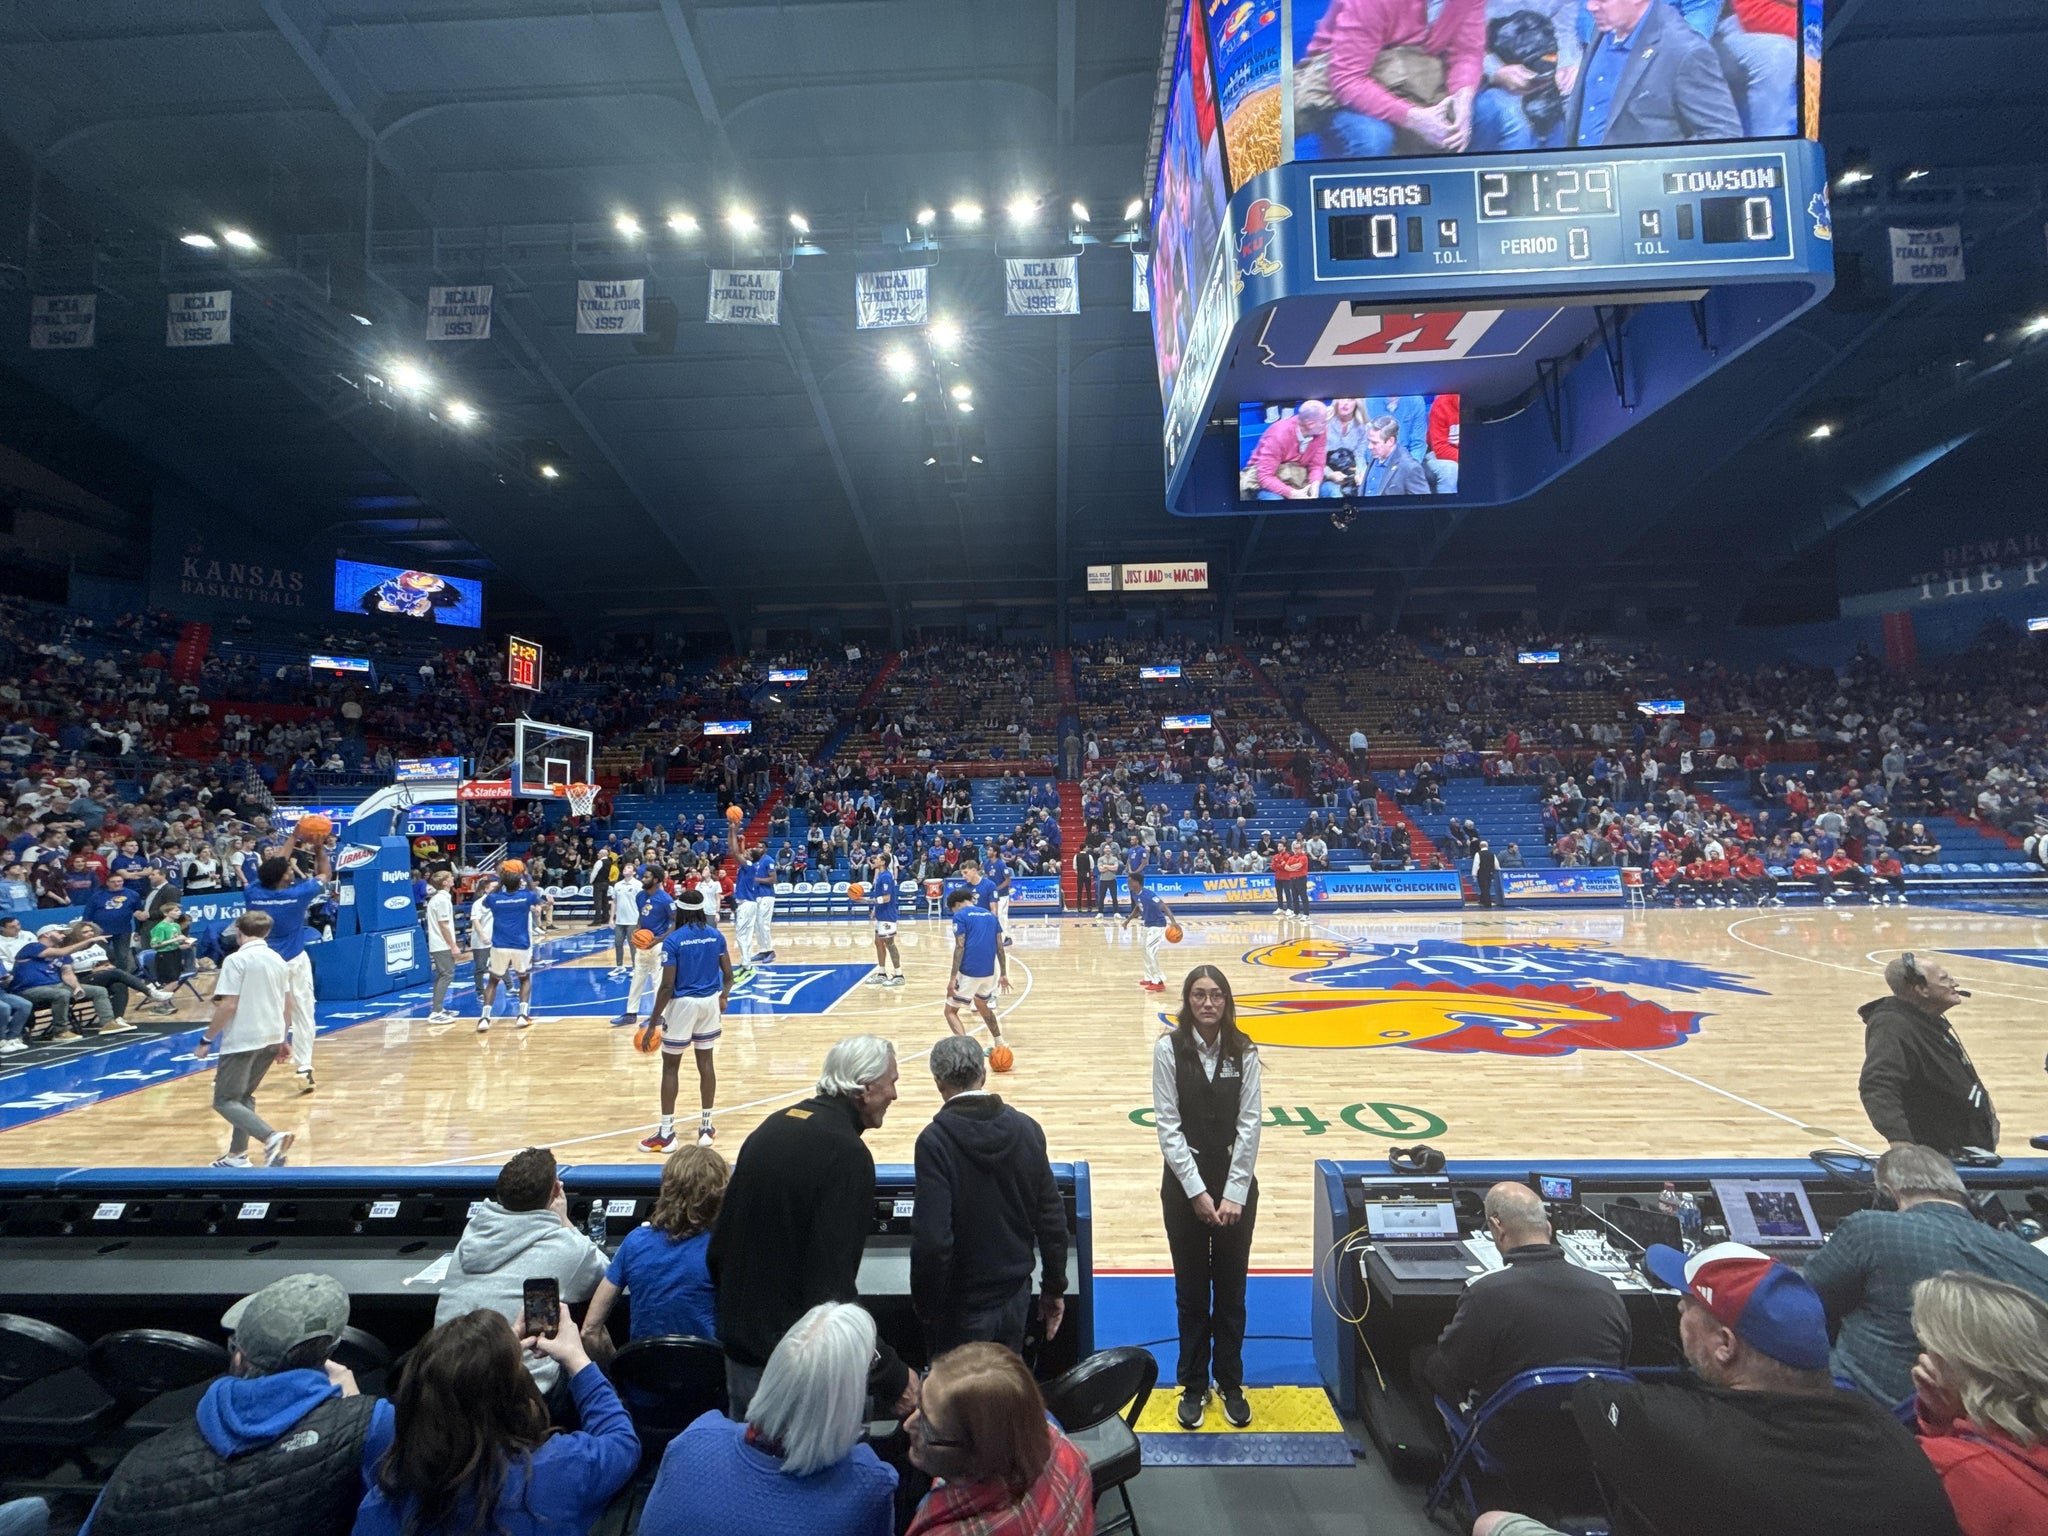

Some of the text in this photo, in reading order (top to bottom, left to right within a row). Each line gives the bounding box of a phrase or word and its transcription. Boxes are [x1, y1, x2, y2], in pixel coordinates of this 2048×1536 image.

[1671, 168, 1776, 193] TOWSON
[1323, 184, 1422, 209] KANSAS
[1484, 169, 1611, 216] 21:29
[1642, 213, 1659, 235] 4
[1745, 196, 1773, 240] 0
[1371, 214, 1398, 258] 0
[1440, 221, 1457, 244] 4
[1501, 237, 1558, 255] PERIOD
[1569, 228, 1589, 259] 0
[1634, 241, 1670, 255] T.O.L.
[1433, 251, 1468, 264] T.O.L.
[1023, 263, 1057, 276] NCAA
[729, 274, 762, 288] NCAA
[875, 275, 908, 289] NCAA
[1010, 278, 1072, 289] FINAL FOUR
[595, 285, 626, 298] NCAA
[714, 289, 776, 301] FINAL FOUR
[862, 289, 923, 303] FINAL FOUR
[580, 299, 640, 310] FINAL FOUR
[1026, 296, 1056, 309] 1986
[730, 306, 757, 318] 1971
[182, 556, 304, 592] KANSAS
[1125, 570, 1142, 584] JUST
[1144, 570, 1163, 583] LOAD
[1174, 568, 1206, 582] WAGON
[181, 579, 305, 607] BASKETBALL
[397, 592, 413, 602] KU
[511, 642, 537, 661] 21:29
[514, 658, 533, 684] 30
[408, 824, 415, 832] 0
[339, 849, 373, 866] LIBMAN
[1158, 882, 1182, 892] Bank
[1203, 878, 1271, 891] WAVE THE
[1332, 882, 1456, 892] JAYHAWK CHECKING
[388, 941, 410, 950] SHELTER
[241, 1208, 256, 1216] SEAT
[896, 1206, 912, 1214] SEAT
